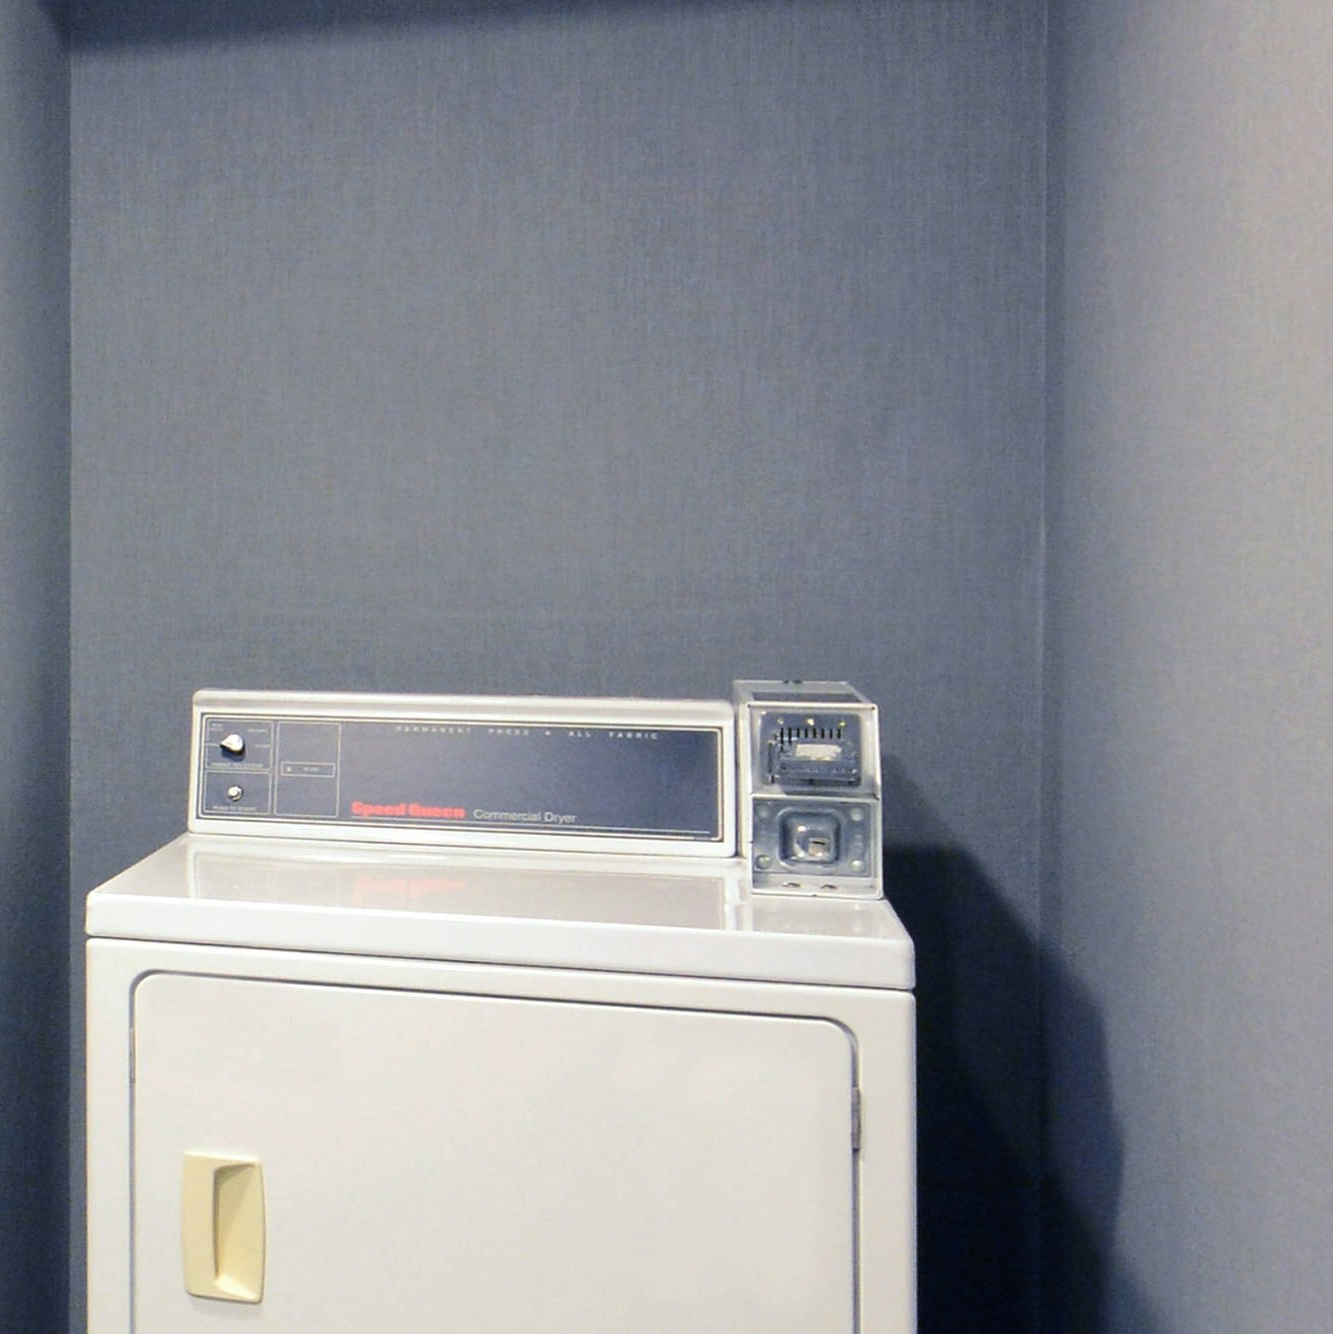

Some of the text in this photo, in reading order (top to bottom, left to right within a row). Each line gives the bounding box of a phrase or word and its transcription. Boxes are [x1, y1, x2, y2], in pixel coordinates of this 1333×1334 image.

[568, 730, 592, 738] ALL
[608, 731, 659, 740] FABRIC
[350, 801, 577, 825] Speed Queen Commercial Dryer
